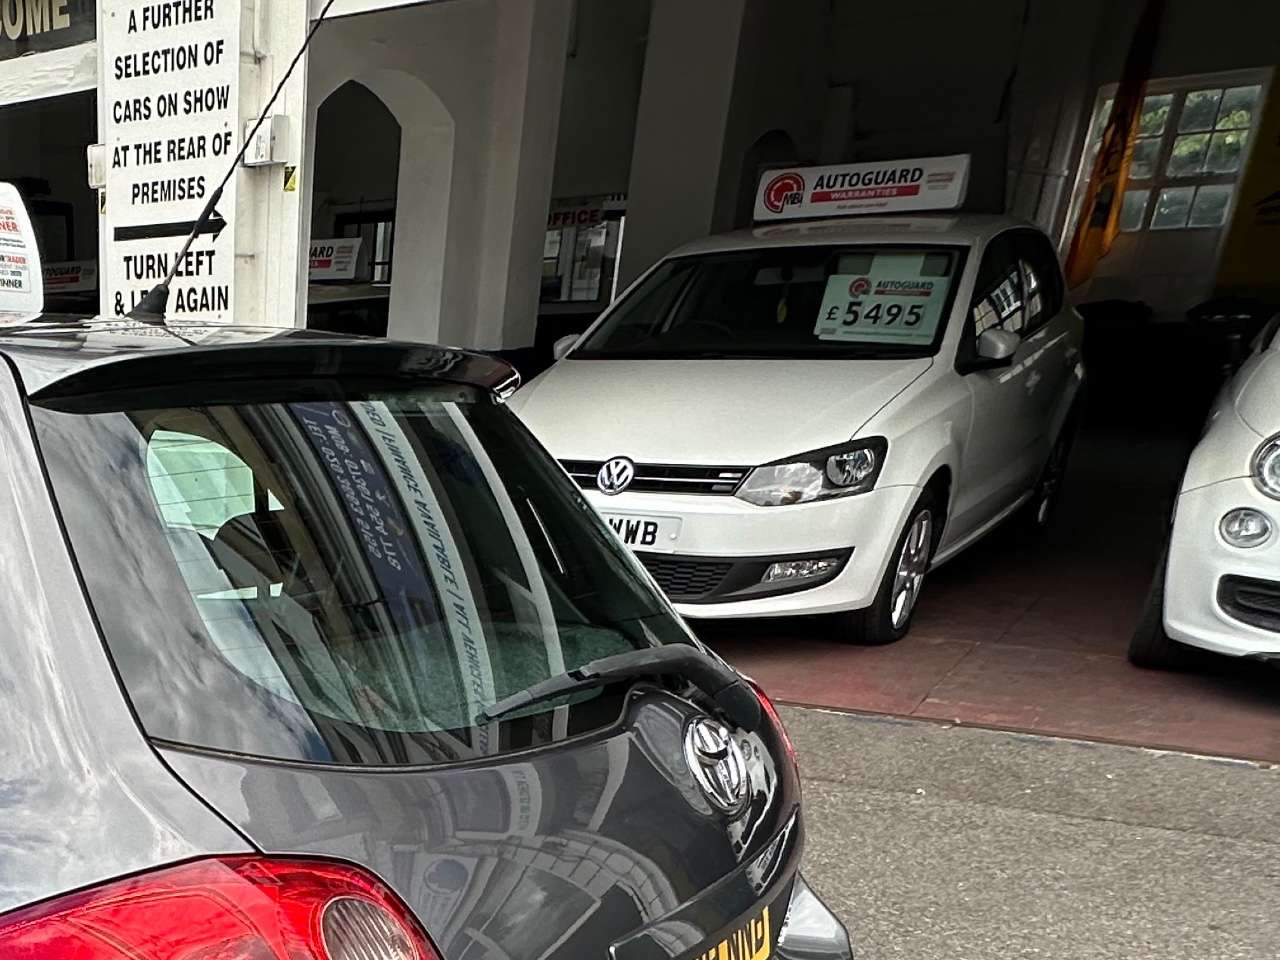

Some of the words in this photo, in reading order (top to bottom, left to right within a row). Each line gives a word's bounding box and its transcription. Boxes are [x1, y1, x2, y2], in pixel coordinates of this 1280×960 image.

[128, 9, 137, 34] A
[142, 0, 214, 31] FURTHER
[115, 44, 198, 80] SELECTION
[204, 39, 224, 66] OF
[113, 97, 151, 124] CARS
[157, 93, 178, 117] ON
[183, 85, 230, 114] SHOW
[112, 144, 131, 169] AT
[135, 141, 162, 165] THE
[167, 137, 206, 161] REAR
[212, 131, 232, 156] OF
[131, 176, 206, 205] PREMISES
[813, 168, 924, 190] AUTOGUARD
[830, 188, 897, 201] WARRANTIES
[548, 209, 599, 226] FFICE
[123, 253, 168, 280] TURN
[175, 249, 216, 277] LEFT
[309, 246, 334, 259] ARD
[876, 280, 934, 291] AUTOGUARD
[115, 291, 125, 316] &
[175, 286, 229, 313] AGAIN
